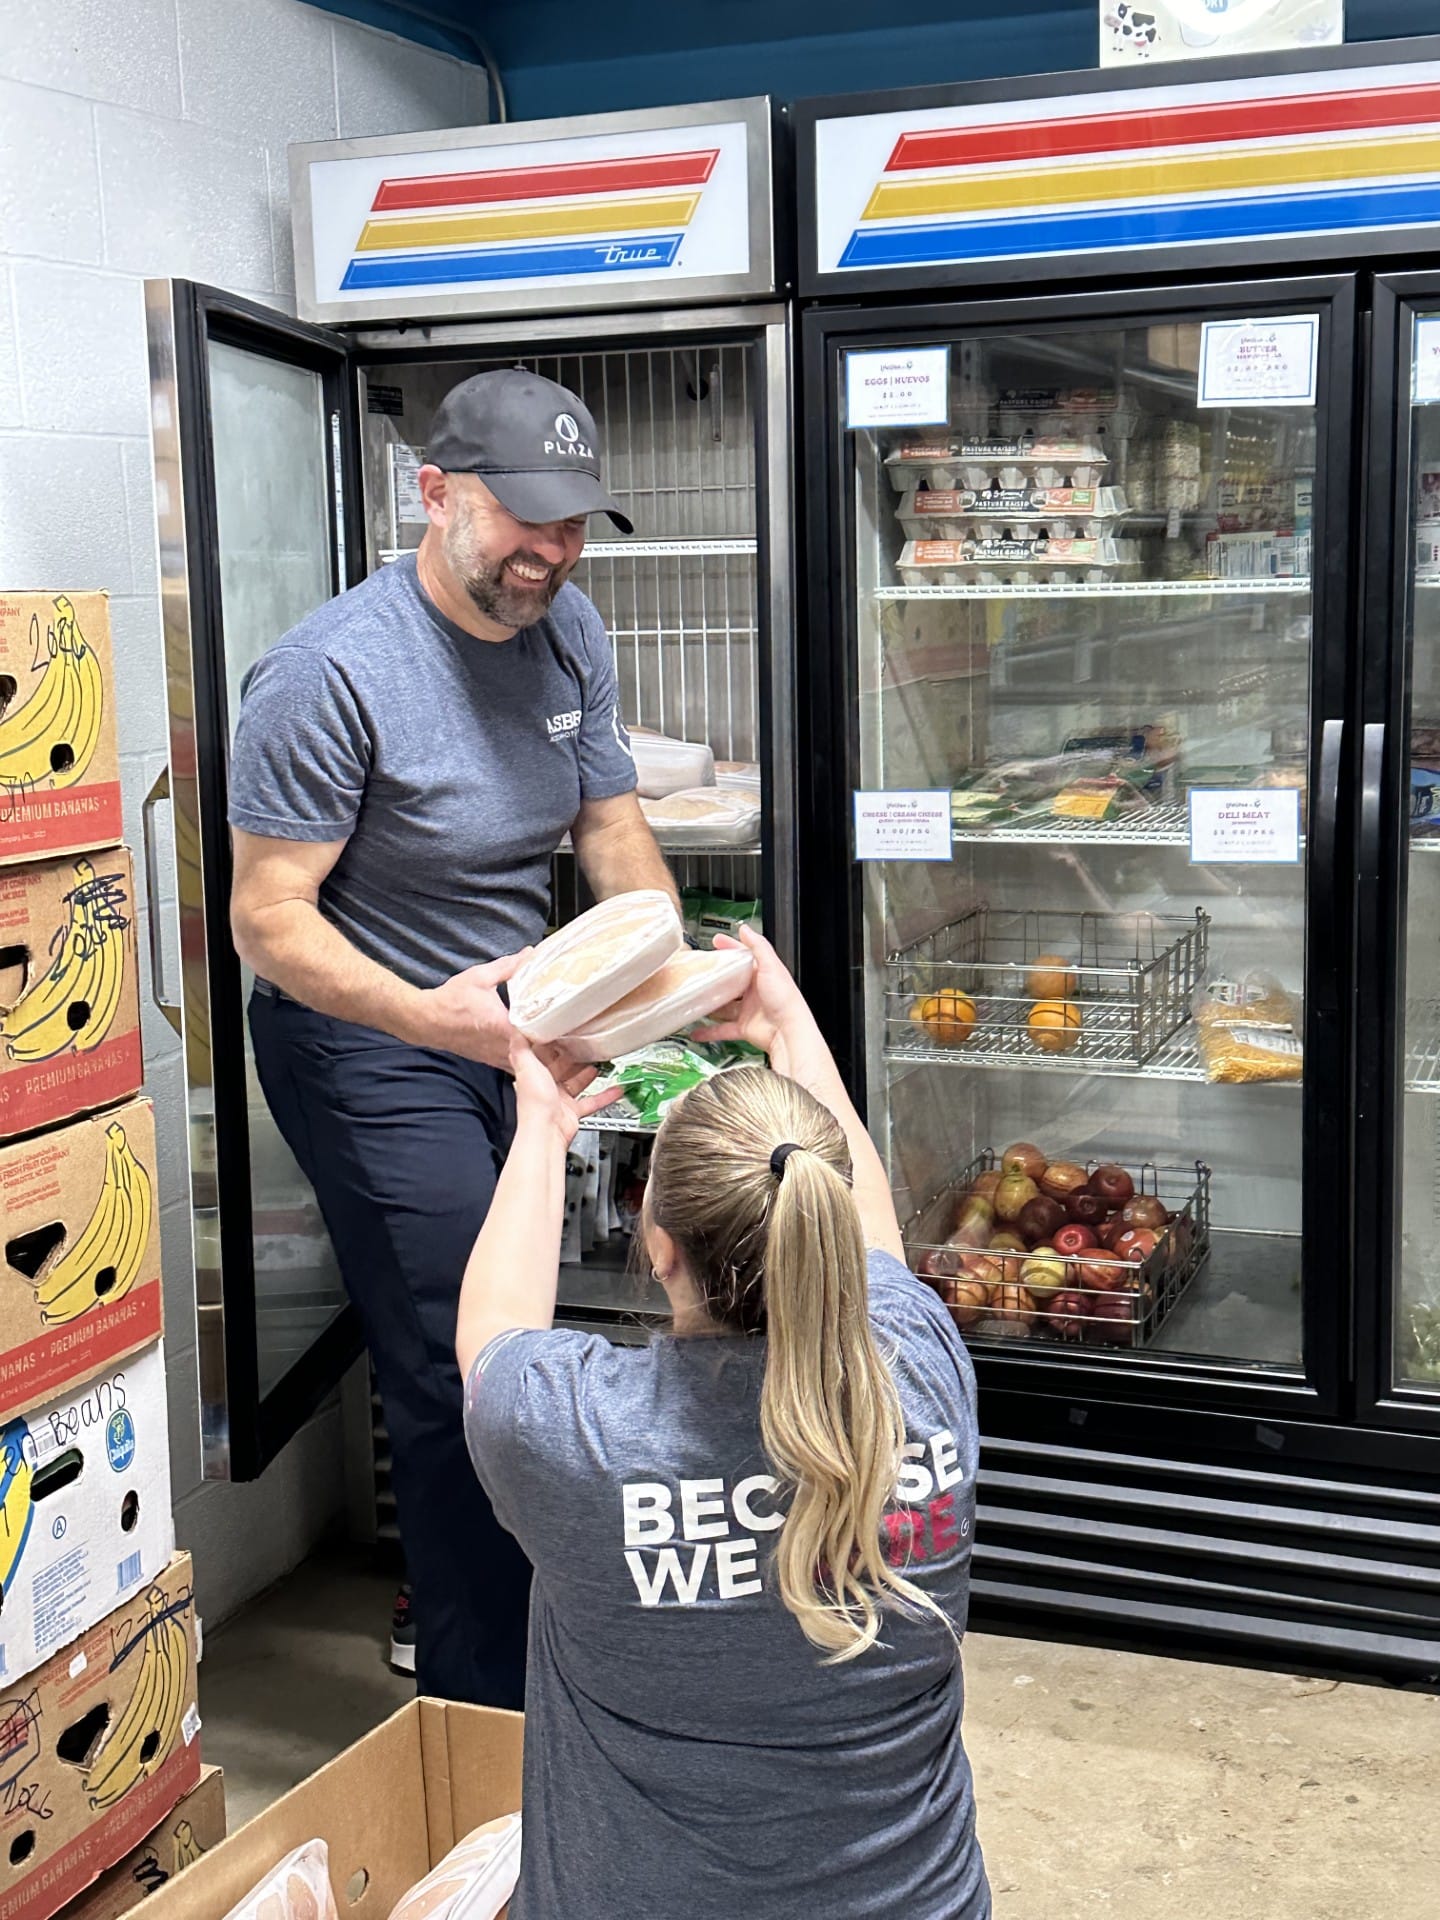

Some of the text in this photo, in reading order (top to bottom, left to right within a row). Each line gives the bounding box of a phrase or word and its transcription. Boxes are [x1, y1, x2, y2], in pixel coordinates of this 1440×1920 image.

[894, 376, 930, 384] HUEVOS
[544, 441, 594, 459] PLAZA
[54, 797, 100, 818] BANANAS
[1242, 811, 1271, 819] MEAT
[25, 1066, 76, 1095] PREMIUM
[50, 1324, 94, 1357] PREMIUM
[96, 1302, 138, 1335] BANANAS
[48, 1373, 126, 1446] Beans
[622, 1429, 964, 1547] BECSE
[623, 1538, 763, 1607] WE
